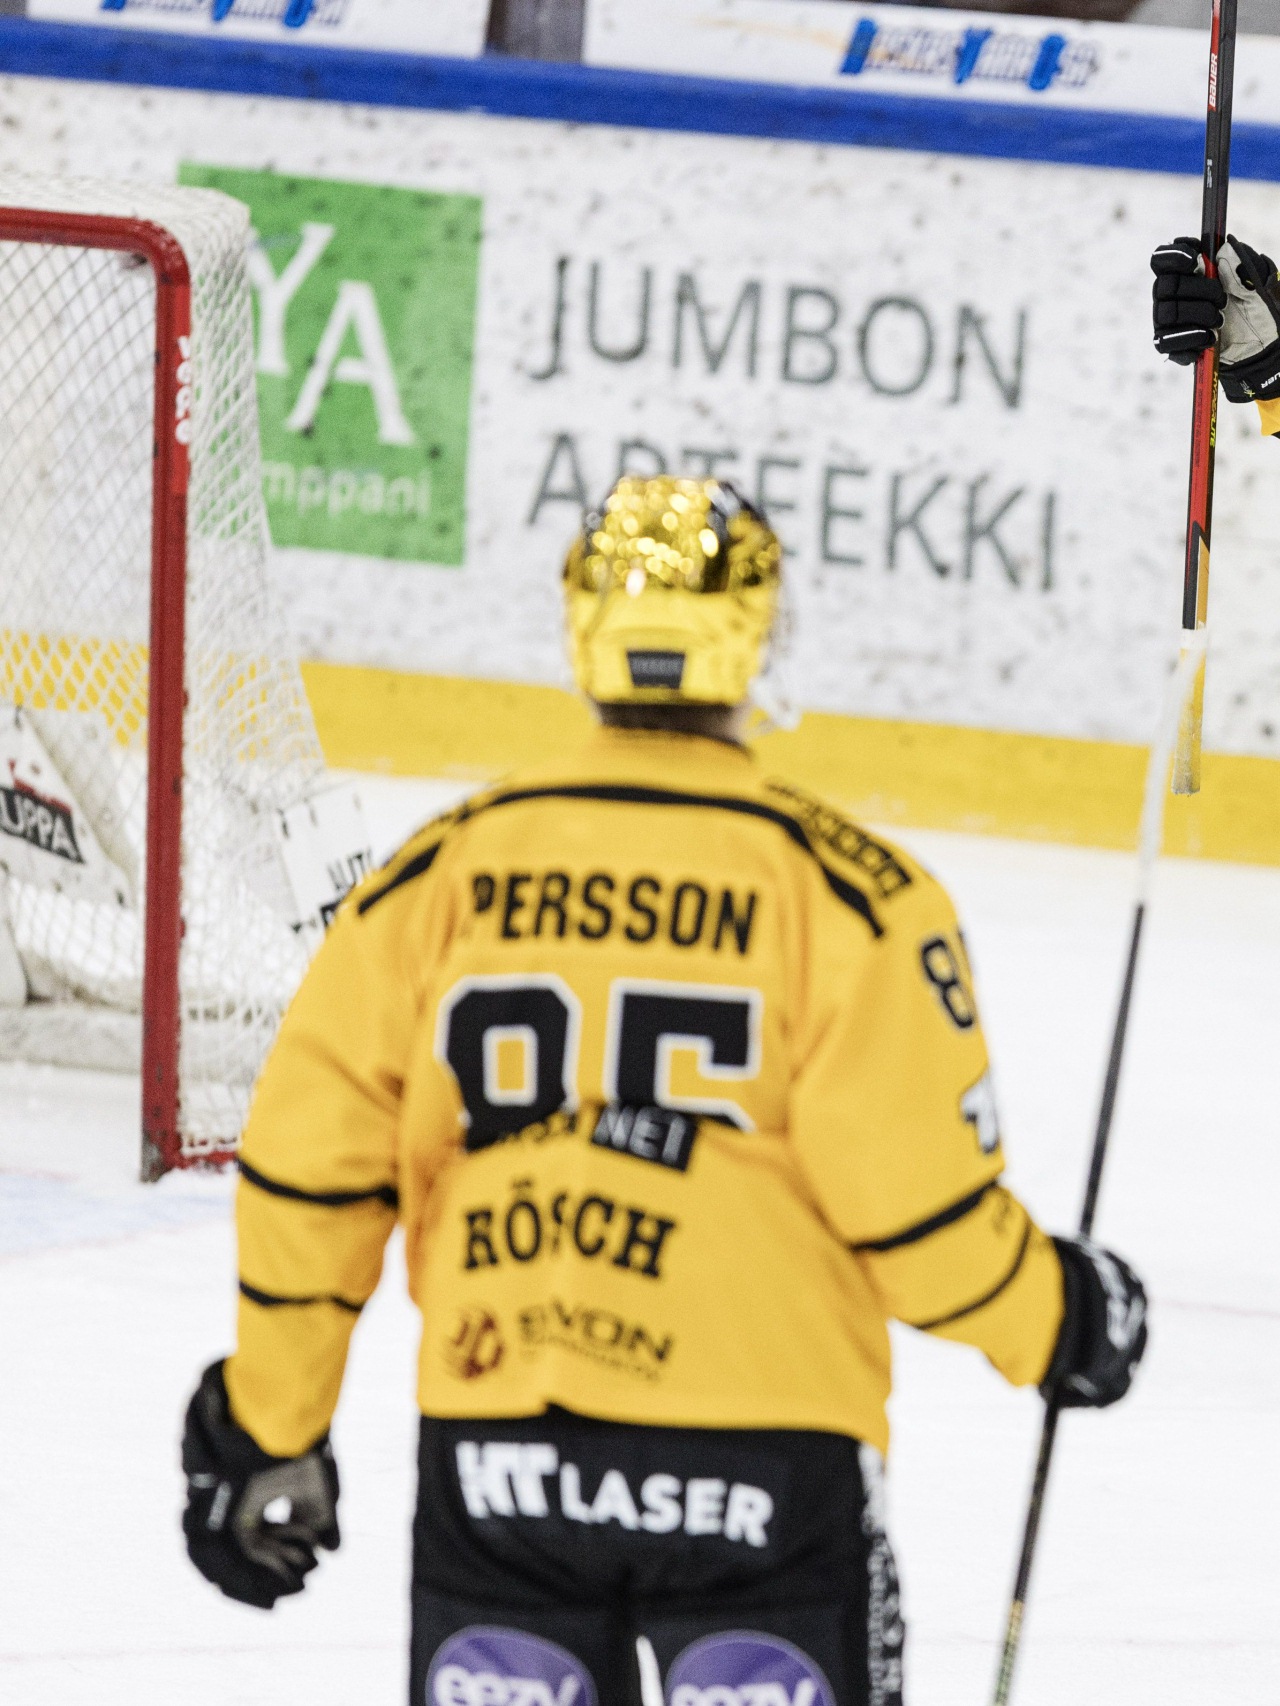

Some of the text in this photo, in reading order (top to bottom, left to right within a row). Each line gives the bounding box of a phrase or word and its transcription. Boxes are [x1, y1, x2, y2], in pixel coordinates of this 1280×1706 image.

[1208, 52, 1218, 108] BAUER
[529, 253, 1030, 408] JUMBON
[526, 430, 1059, 594] AEEKKI
[471, 871, 758, 956] PERSSON
[558, 1461, 775, 1549] LASER
